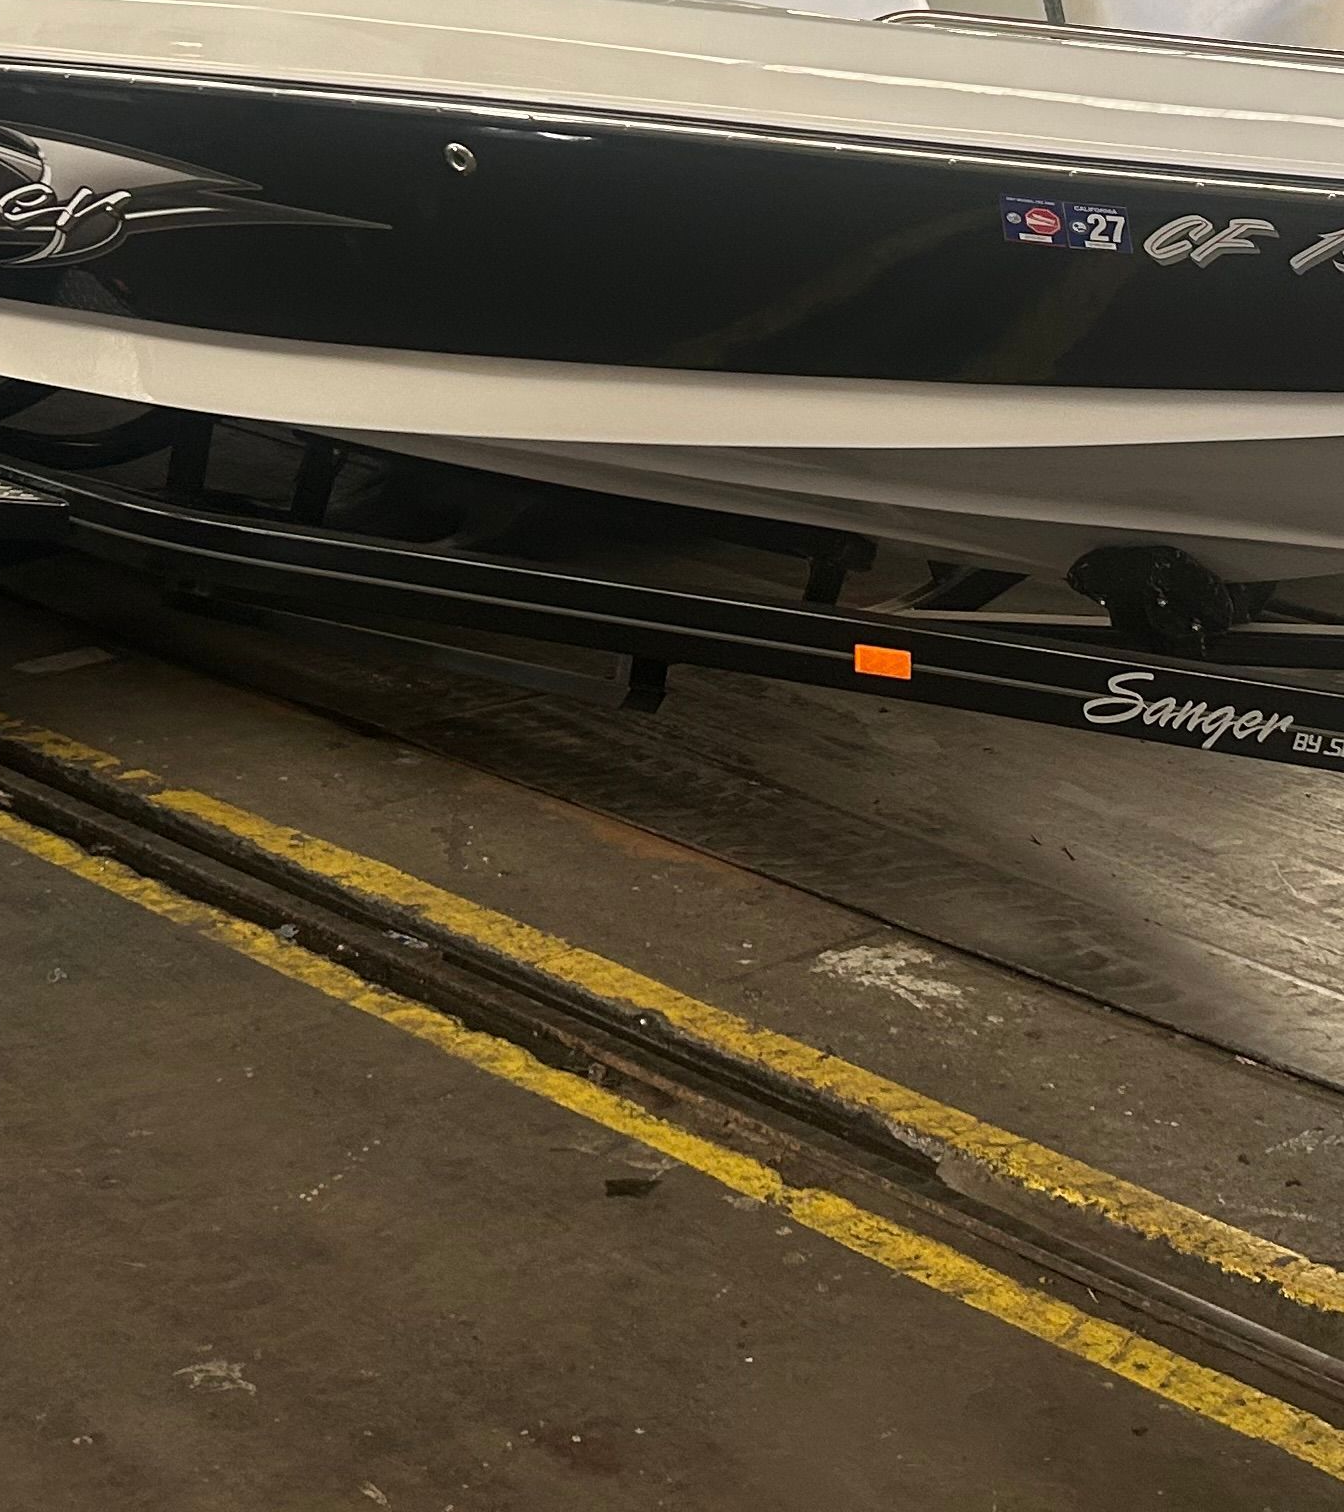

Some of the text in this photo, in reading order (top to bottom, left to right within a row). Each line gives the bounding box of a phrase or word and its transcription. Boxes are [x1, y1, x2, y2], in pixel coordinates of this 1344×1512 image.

[1086, 213, 1126, 244] 27
[1142, 214, 1278, 268] CF
[1083, 671, 1294, 750] Sanger
[1292, 733, 1323, 753] BY
